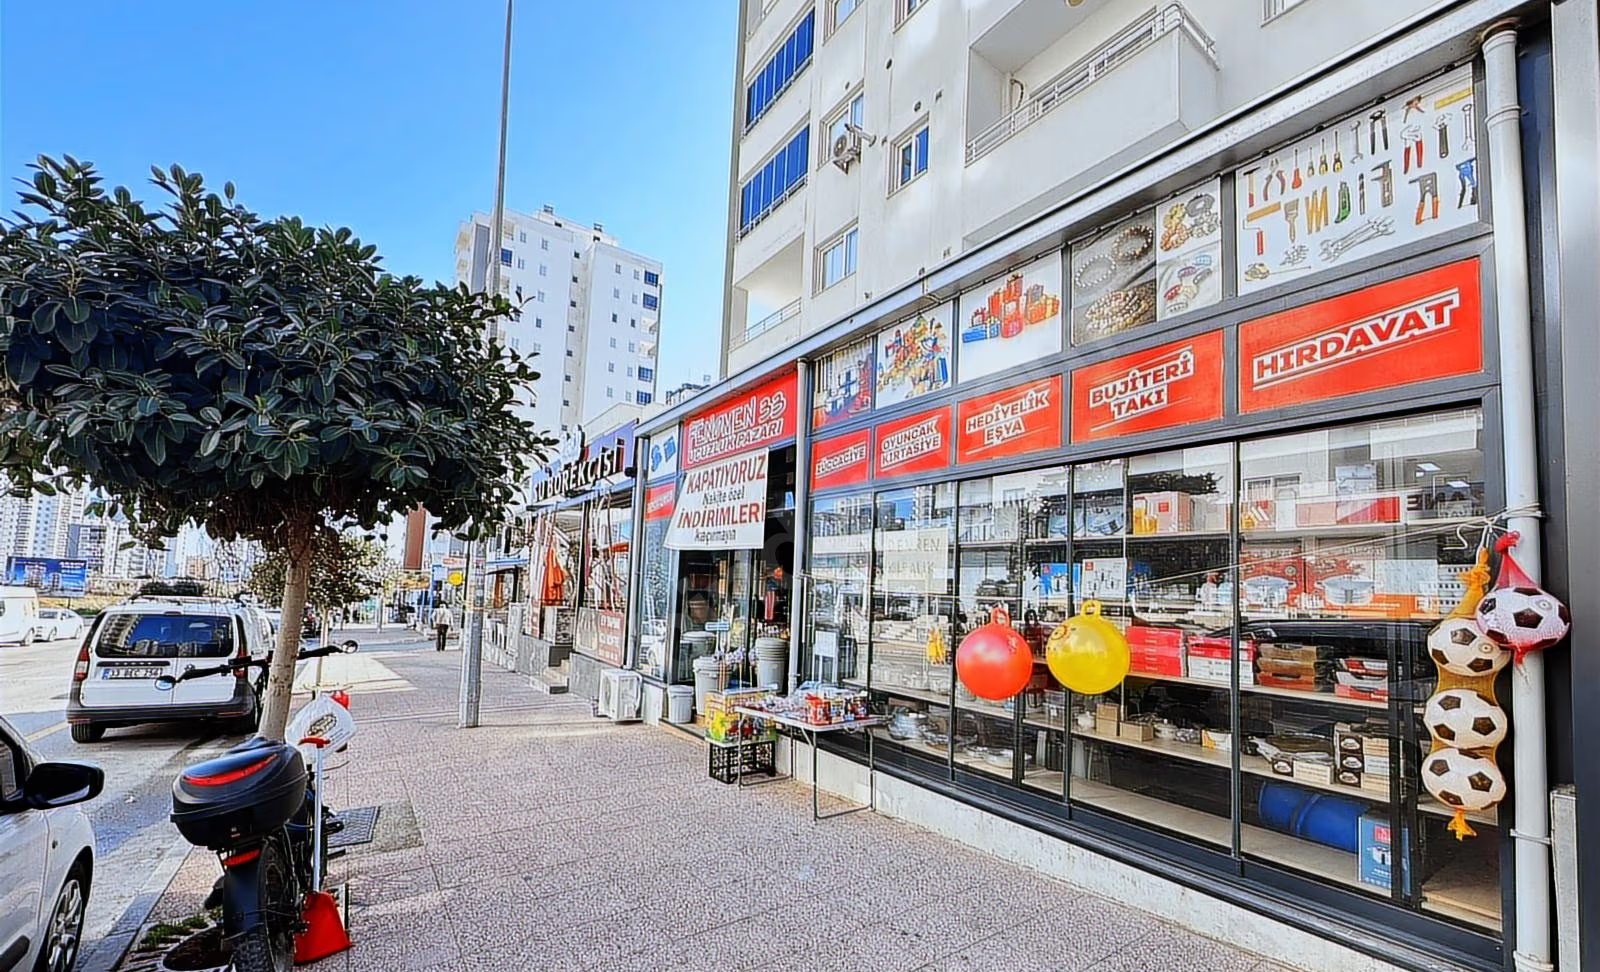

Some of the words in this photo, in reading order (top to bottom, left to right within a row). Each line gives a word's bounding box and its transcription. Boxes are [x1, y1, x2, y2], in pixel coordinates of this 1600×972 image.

[1257, 299, 1453, 379] HIRDAVAT
[1091, 353, 1191, 404] BUJİTERİ
[759, 391, 786, 422] 33
[967, 393, 1046, 431] HEDİYELİK
[1113, 389, 1164, 416] TAKI
[735, 418, 784, 450] PAZARI
[882, 424, 935, 450] OYUNCAK
[986, 419, 1022, 441] EŞYA
[881, 436, 939, 465] KIRTASİYE
[686, 453, 766, 495] KAPATIYORUZ
[677, 496, 765, 529] İNDİRİMLERİ
